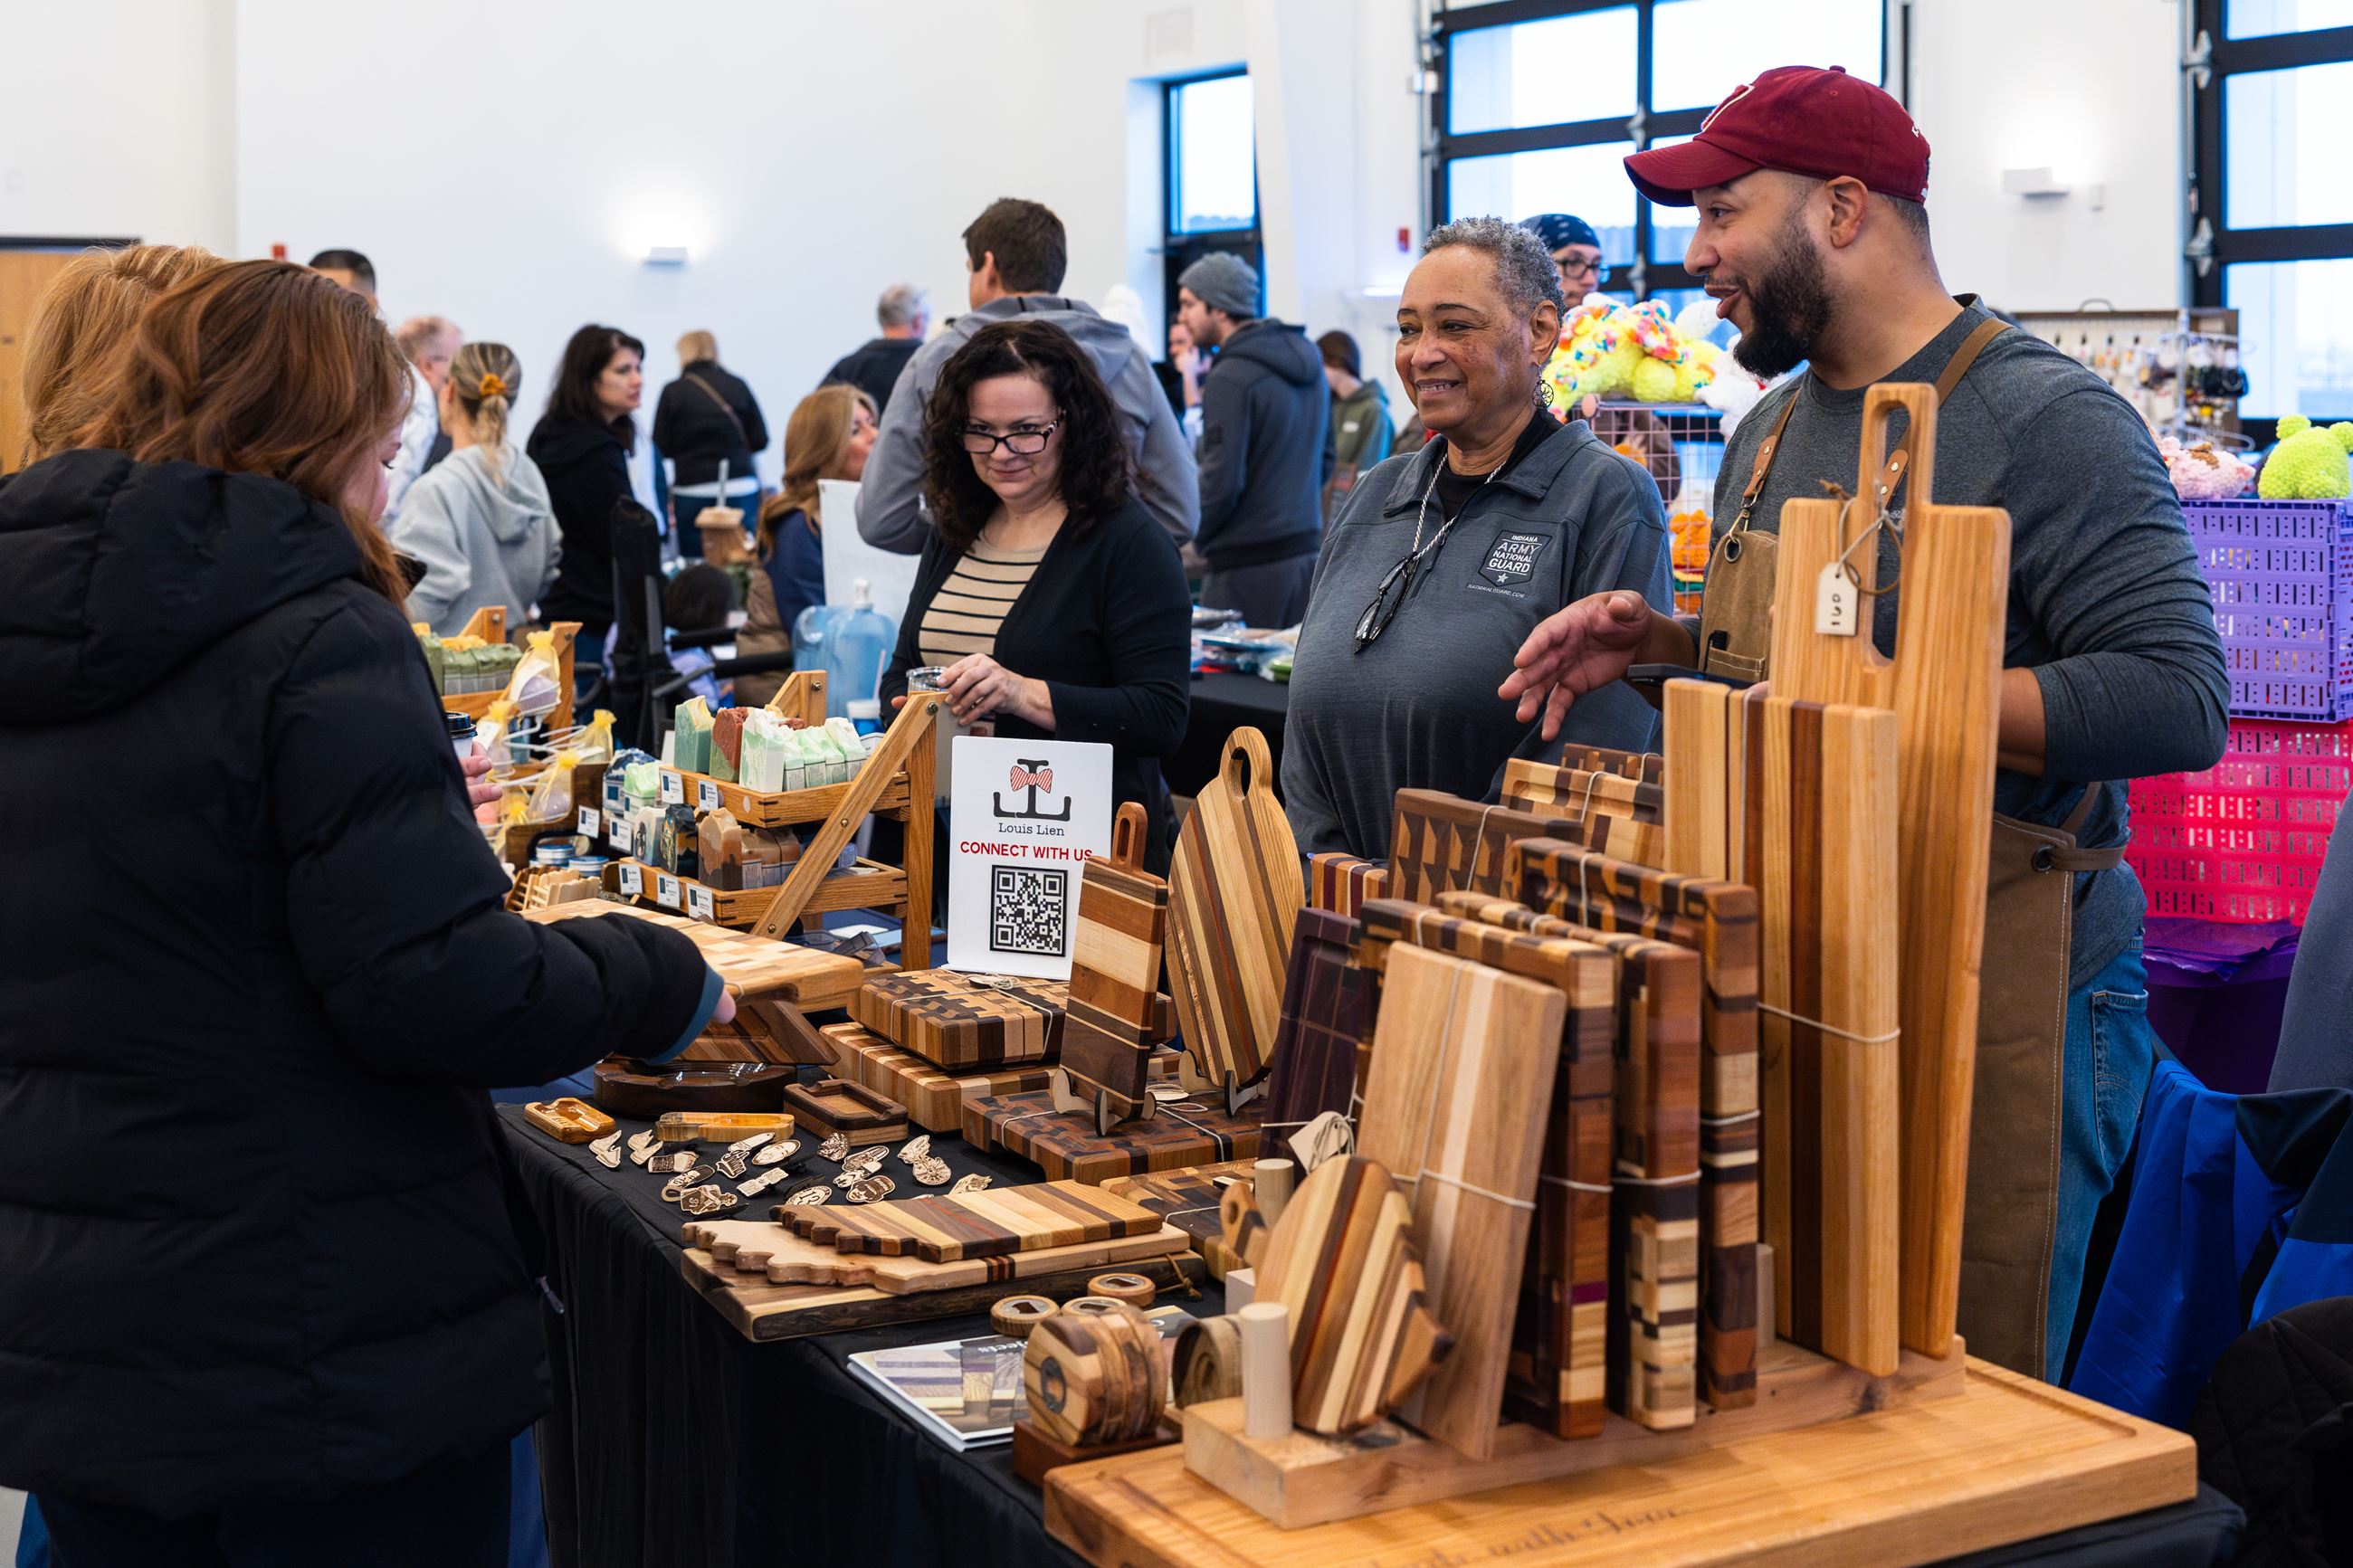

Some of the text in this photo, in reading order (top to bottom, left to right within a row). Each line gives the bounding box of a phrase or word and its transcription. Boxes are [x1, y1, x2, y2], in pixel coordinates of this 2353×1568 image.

[1511, 535, 1538, 543] INDIANA
[1497, 542, 1540, 555] ARMY
[1492, 550, 1532, 563] NATIONAL
[1489, 558, 1530, 573] GUARD
[998, 822, 1065, 836] Louis Lien
[960, 841, 1092, 861] CONNECT WITH US
